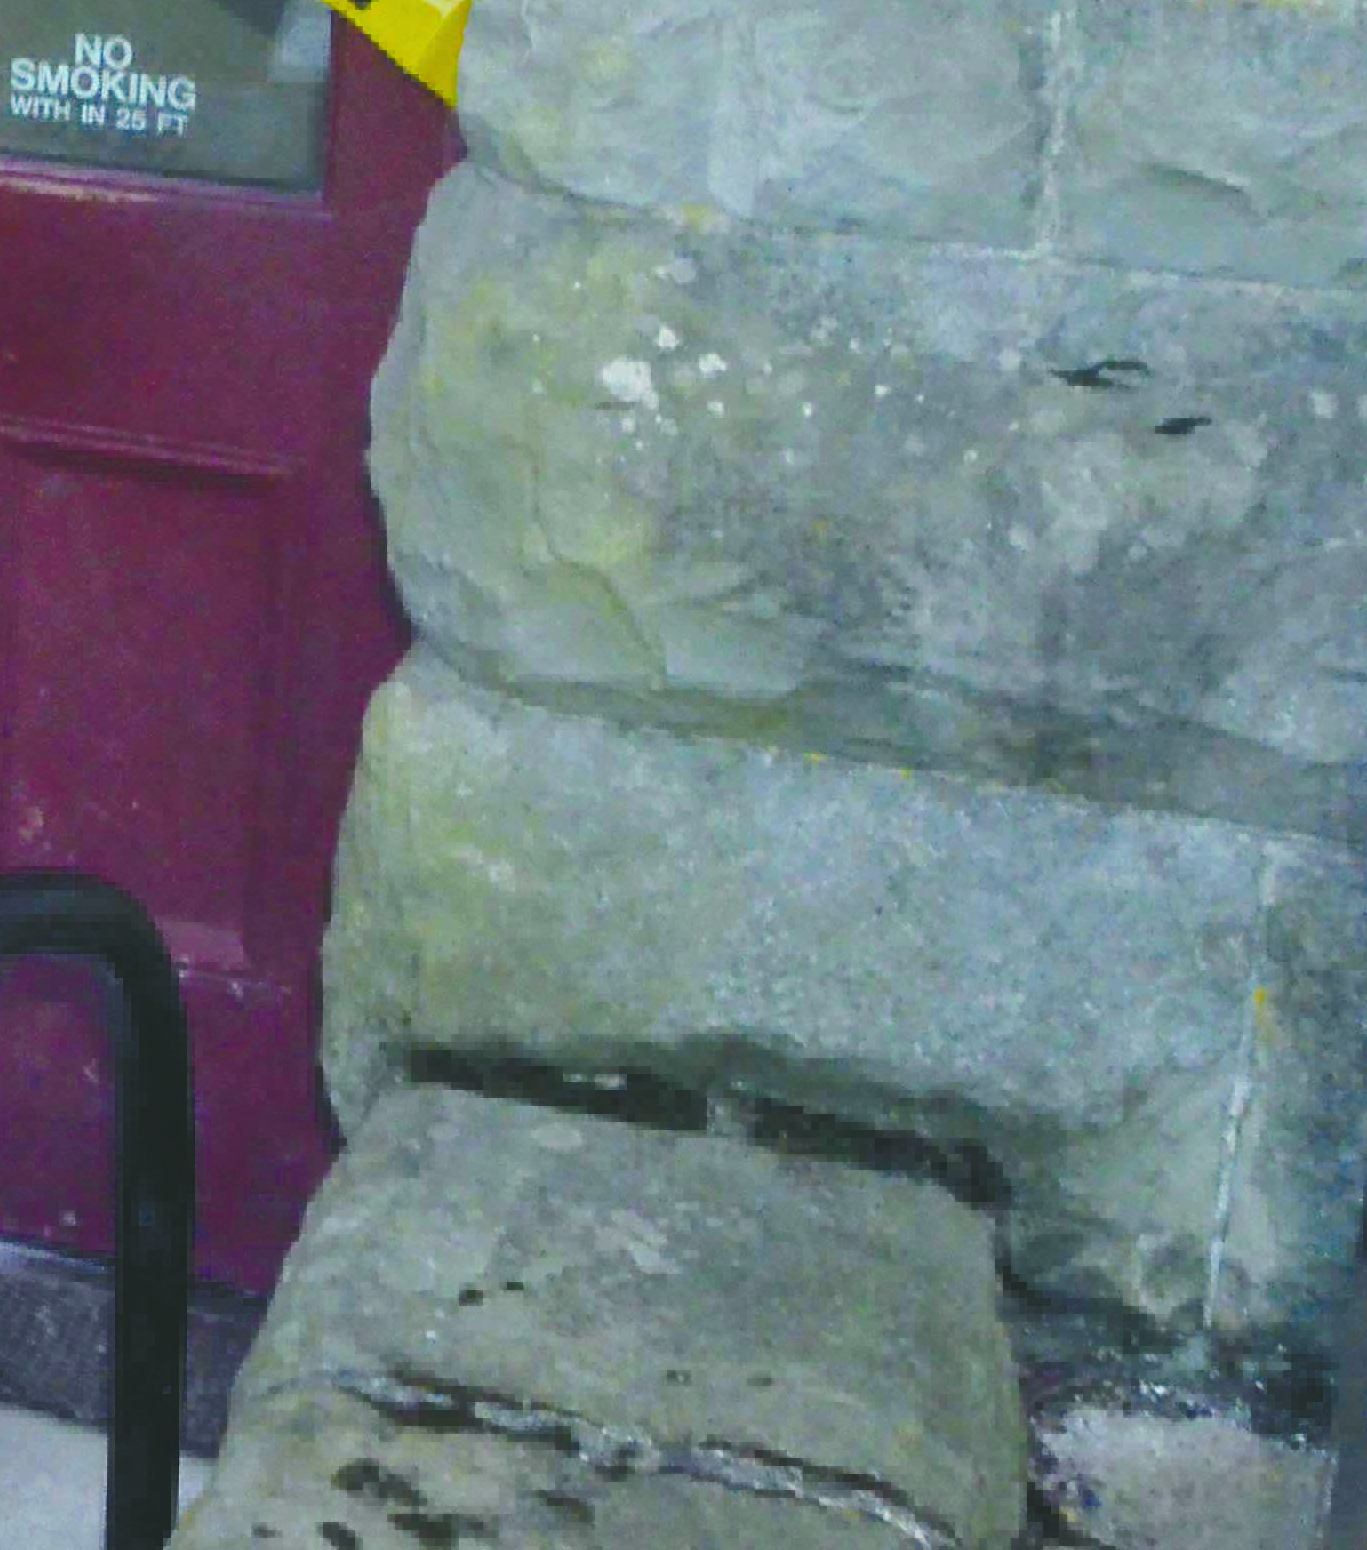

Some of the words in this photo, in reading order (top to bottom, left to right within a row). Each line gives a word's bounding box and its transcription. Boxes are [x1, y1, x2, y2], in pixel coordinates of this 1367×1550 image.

[75, 34, 132, 69] NO
[11, 57, 196, 109] SMOKING
[11, 95, 71, 121] WITH
[82, 105, 106, 125] IN
[116, 107, 148, 131] 25
[156, 113, 188, 137] FT
